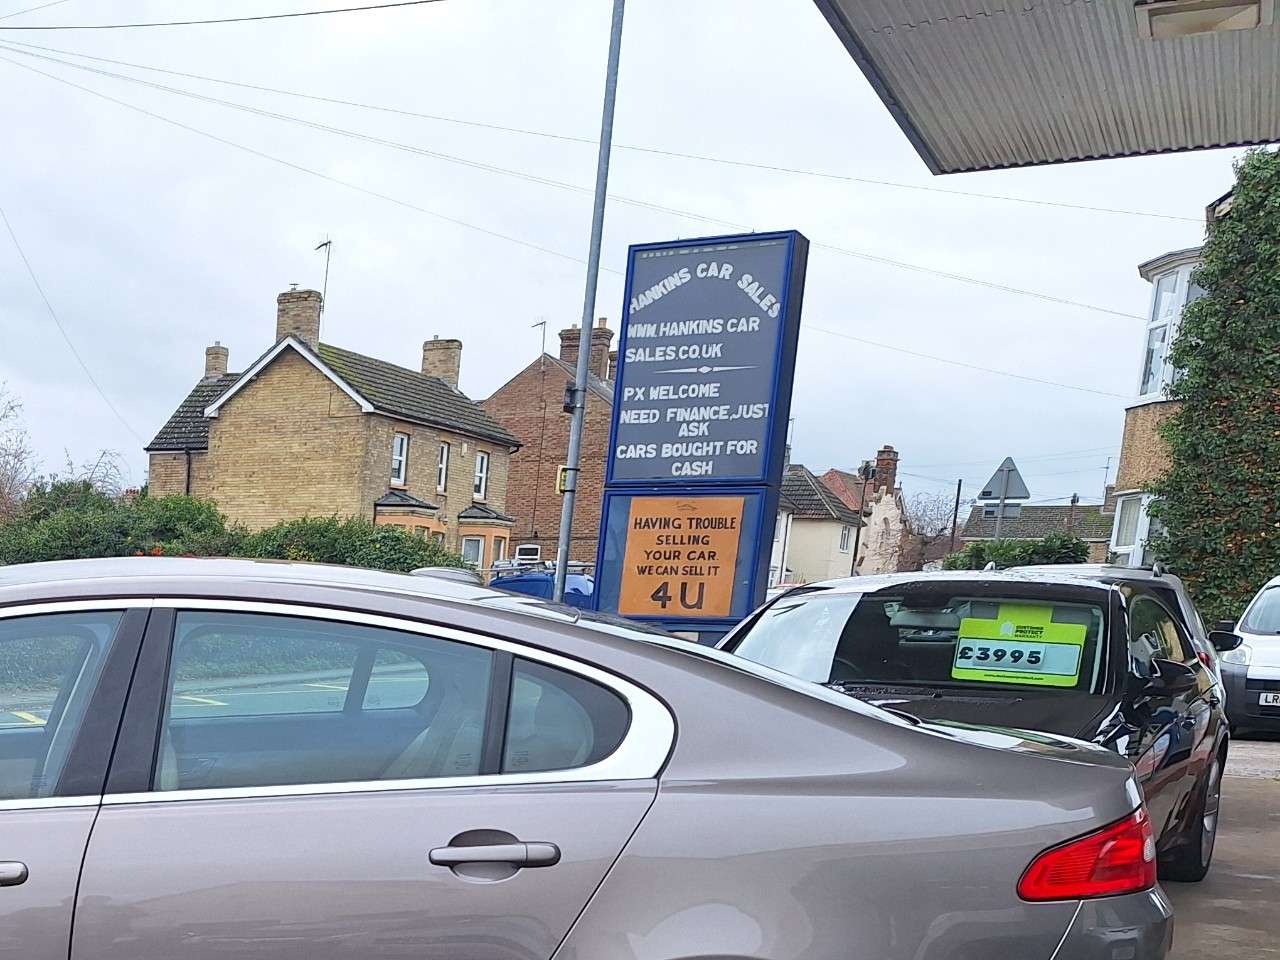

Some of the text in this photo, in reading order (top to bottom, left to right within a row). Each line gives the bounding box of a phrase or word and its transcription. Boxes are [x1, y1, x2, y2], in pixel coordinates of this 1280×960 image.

[629, 261, 780, 318] HANKINS CAR SALES
[726, 316, 761, 333] CAR
[625, 344, 723, 362] SALES.CO.UK
[623, 383, 721, 402] PX WELCOME
[620, 409, 660, 424] NEED
[678, 421, 710, 438] ASK
[616, 440, 758, 459] CARS BOUGHT FOR
[671, 460, 713, 476] CASH
[633, 516, 737, 530] HAVING TROUBLE
[655, 534, 710, 546] SELLING
[644, 550, 681, 561] YOUR
[636, 565, 720, 577] WE CAN SELL IT
[650, 581, 705, 610] 4 U
[958, 646, 1041, 665] £3995
[1264, 694, 1280, 705] LR
